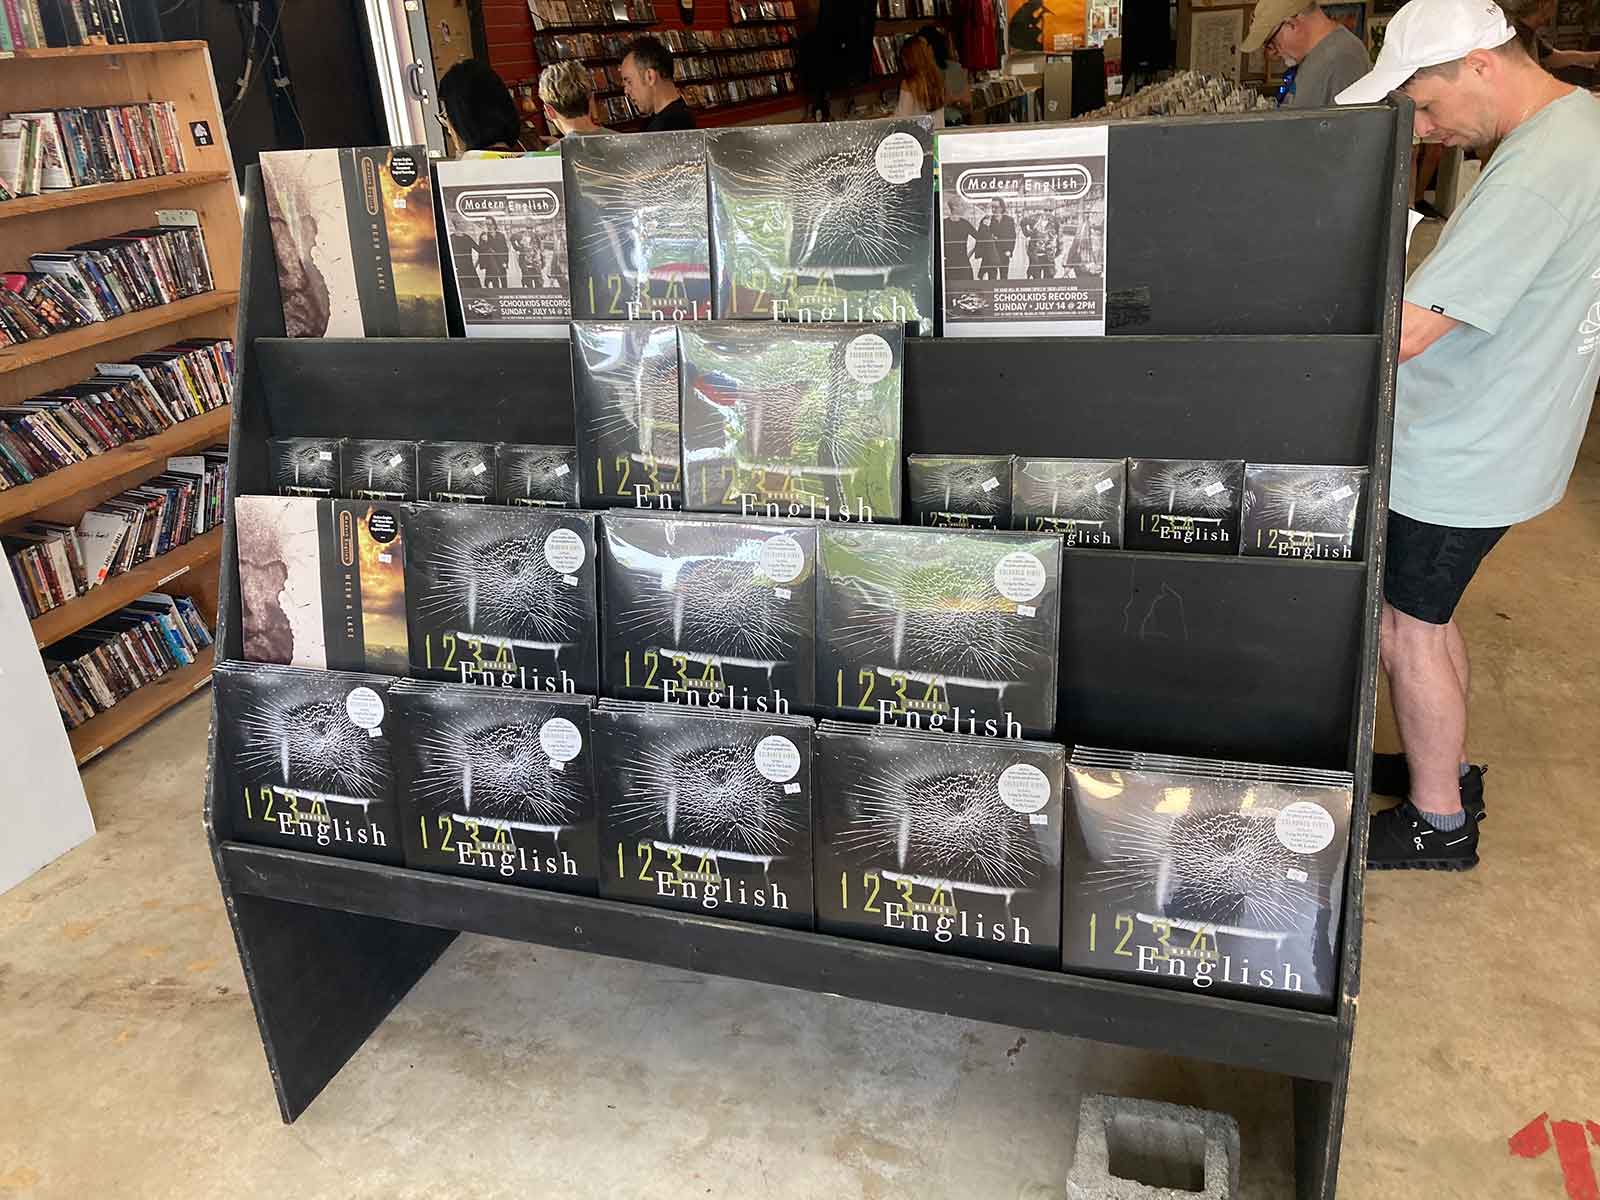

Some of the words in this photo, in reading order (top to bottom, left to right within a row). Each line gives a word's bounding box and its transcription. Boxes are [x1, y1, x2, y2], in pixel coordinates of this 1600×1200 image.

[967, 179, 1018, 190] Modern
[1024, 177, 1077, 194] English
[464, 199, 504, 210] Modern
[508, 199, 549, 212] English
[501, 308, 526, 316] SUNDAY
[532, 307, 547, 315] JULY
[549, 307, 556, 315] 14
[607, 274, 624, 314] 2
[771, 297, 906, 324] English
[994, 293, 1047, 302] SCHOOLKIDS
[1048, 291, 1088, 301] RECORDS
[994, 302, 1028, 311] SUNDAY
[1034, 302, 1055, 311] JULY
[1056, 302, 1066, 310] 14
[1076, 301, 1096, 310] 2PM
[616, 456, 632, 496] 2
[633, 484, 681, 510] En
[741, 493, 874, 524] English
[1151, 515, 1160, 532] 2
[1160, 526, 1230, 543] English
[1268, 529, 1278, 549] 2
[1277, 542, 1352, 560] English
[443, 634, 458, 671] 2
[644, 651, 659, 689] 2
[459, 661, 576, 694] English
[859, 671, 875, 710] 2
[661, 679, 790, 716] English
[877, 699, 1023, 740] English
[260, 787, 276, 822] 2
[277, 812, 387, 847] English
[438, 815, 455, 852] 2
[456, 841, 579, 877] English
[637, 842, 654, 881] 2
[656, 870, 789, 909] English
[863, 873, 881, 912] 2
[883, 901, 1032, 943] English
[1113, 914, 1134, 957] 2
[1136, 945, 1304, 988] English
